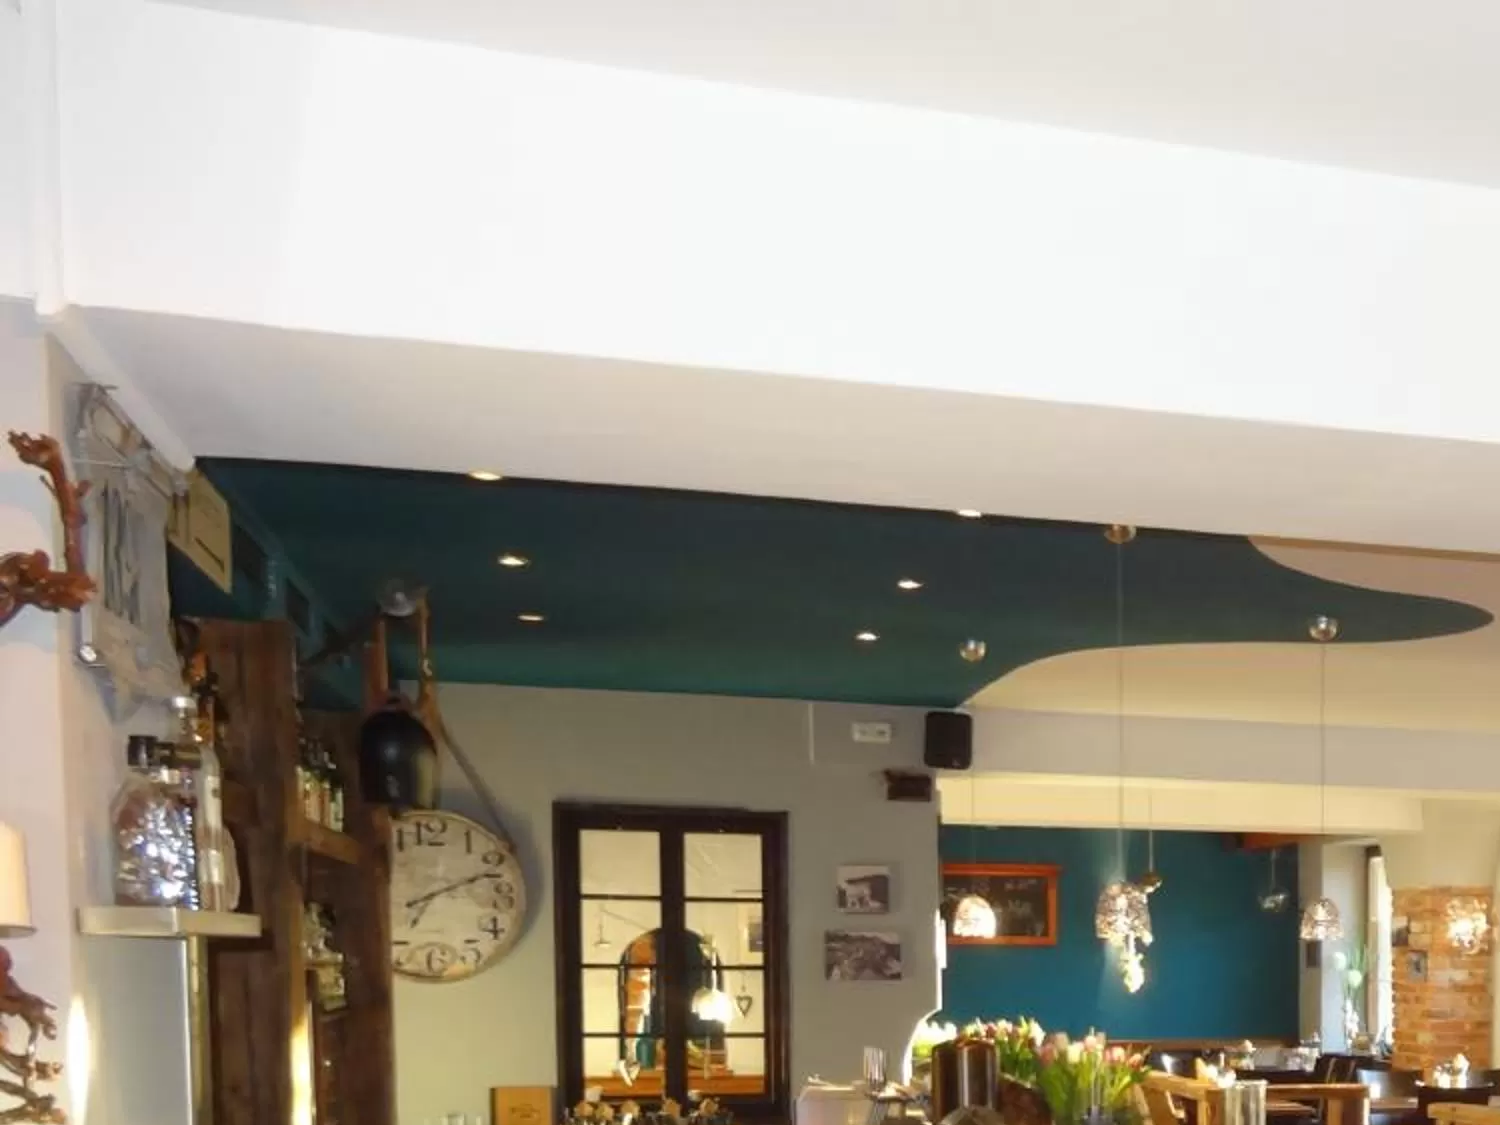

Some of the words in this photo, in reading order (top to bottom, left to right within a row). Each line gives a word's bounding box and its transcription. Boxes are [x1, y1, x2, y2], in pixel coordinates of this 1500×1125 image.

[414, 820, 448, 847] 12
[463, 829, 473, 855] 1
[480, 850, 506, 880] 2
[491, 880, 516, 911] 3
[479, 915, 506, 941] 4
[425, 947, 449, 974] 6
[458, 938, 482, 966] 5
